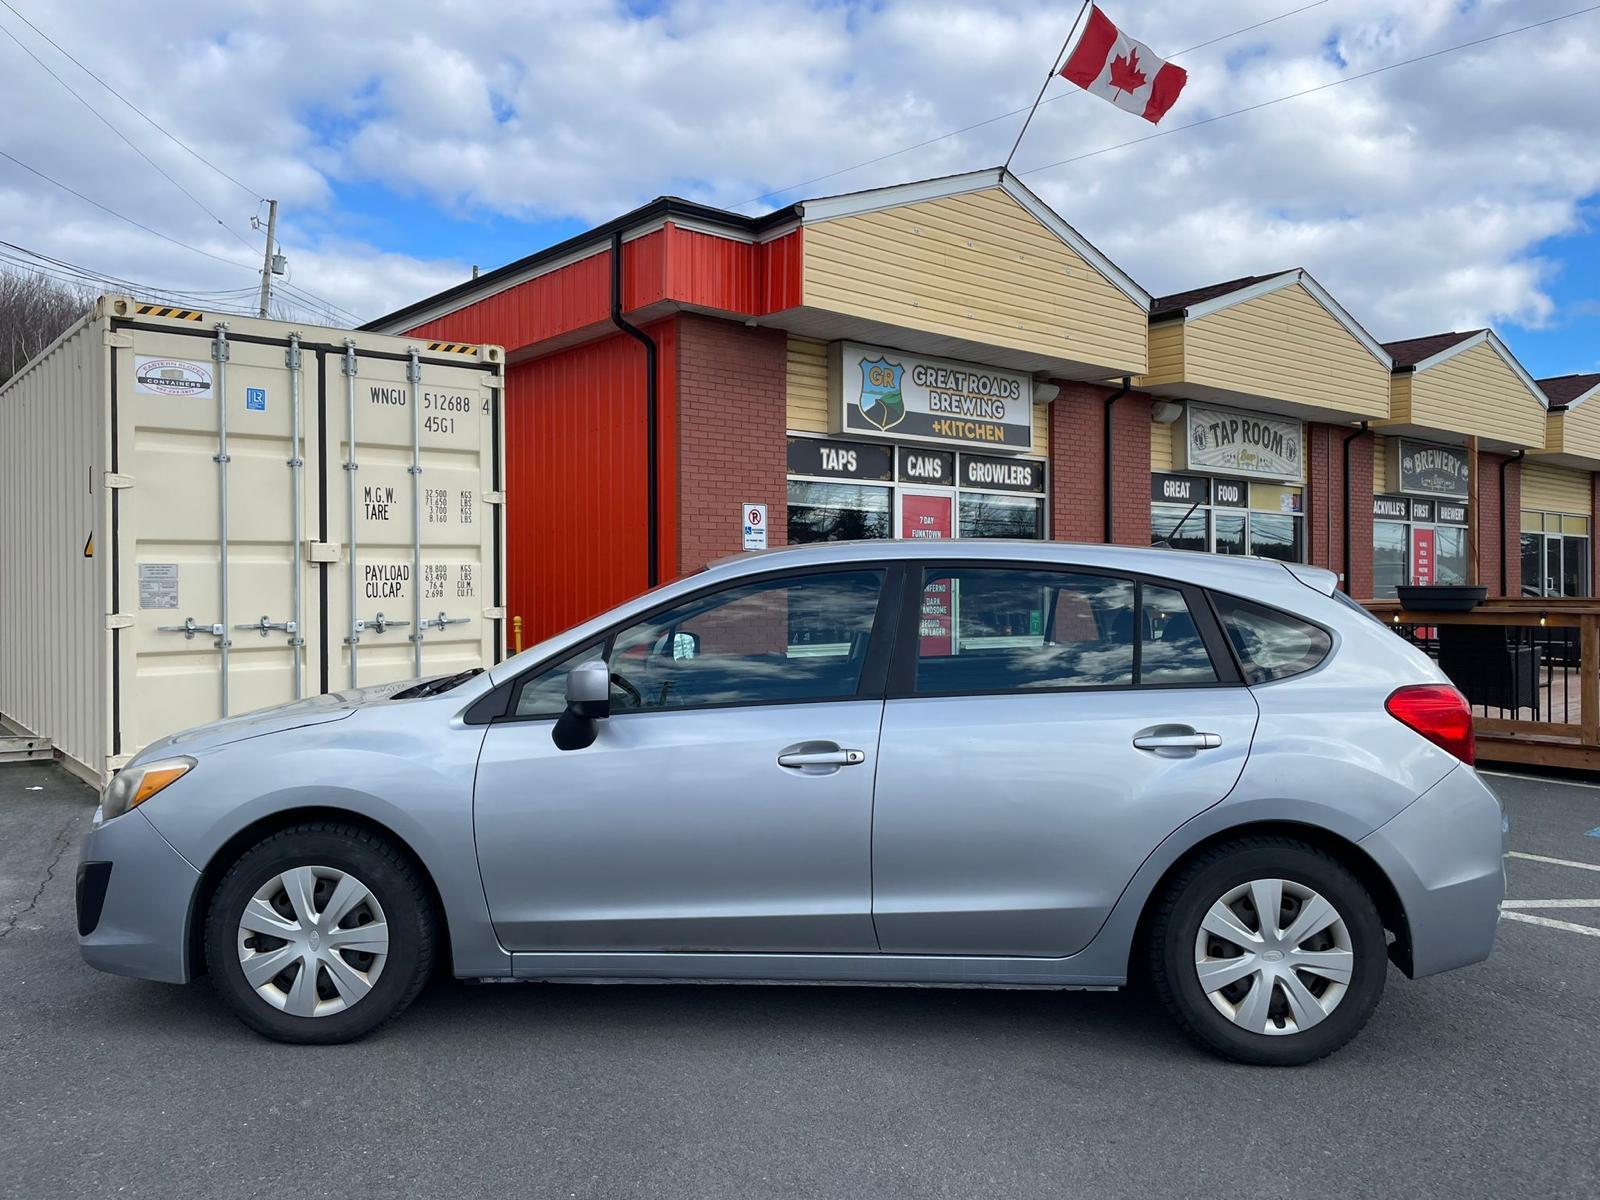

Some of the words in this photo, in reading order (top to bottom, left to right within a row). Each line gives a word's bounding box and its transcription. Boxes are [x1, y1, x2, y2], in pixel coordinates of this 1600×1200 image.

[147, 378, 201, 388] CONTAINERS
[869, 366, 895, 389] GR
[912, 364, 967, 392] GREAT
[968, 373, 1020, 400] ROADS
[370, 387, 406, 406] WNGU
[424, 393, 470, 413] 512688
[482, 399, 490, 415] 4
[929, 391, 1005, 420] BREWING
[424, 416, 454, 434] 45G1
[932, 420, 1005, 441] +KITCHEN
[1209, 420, 1239, 448] TAP
[1241, 420, 1283, 458] ROOM
[820, 447, 857, 472] TAPS
[907, 455, 942, 478] CANS
[1413, 449, 1461, 477] BREWERY
[968, 462, 1032, 486] GROWLERS
[364, 486, 397, 504] M.G.W.
[460, 490, 472, 499] KGS
[1163, 480, 1190, 498] GREAT
[1218, 485, 1238, 502] FOOD
[365, 503, 389, 520] TARE
[460, 499, 472, 507] LBS
[1413, 503, 1429, 518] FIRST
[1440, 506, 1465, 521] BREWERY
[460, 515, 472, 523] LBS
[365, 565, 410, 581] PAYLOAD
[460, 565, 472, 573] KGS
[460, 573, 472, 581] LBS
[365, 582, 405, 598] CU.CAP.
